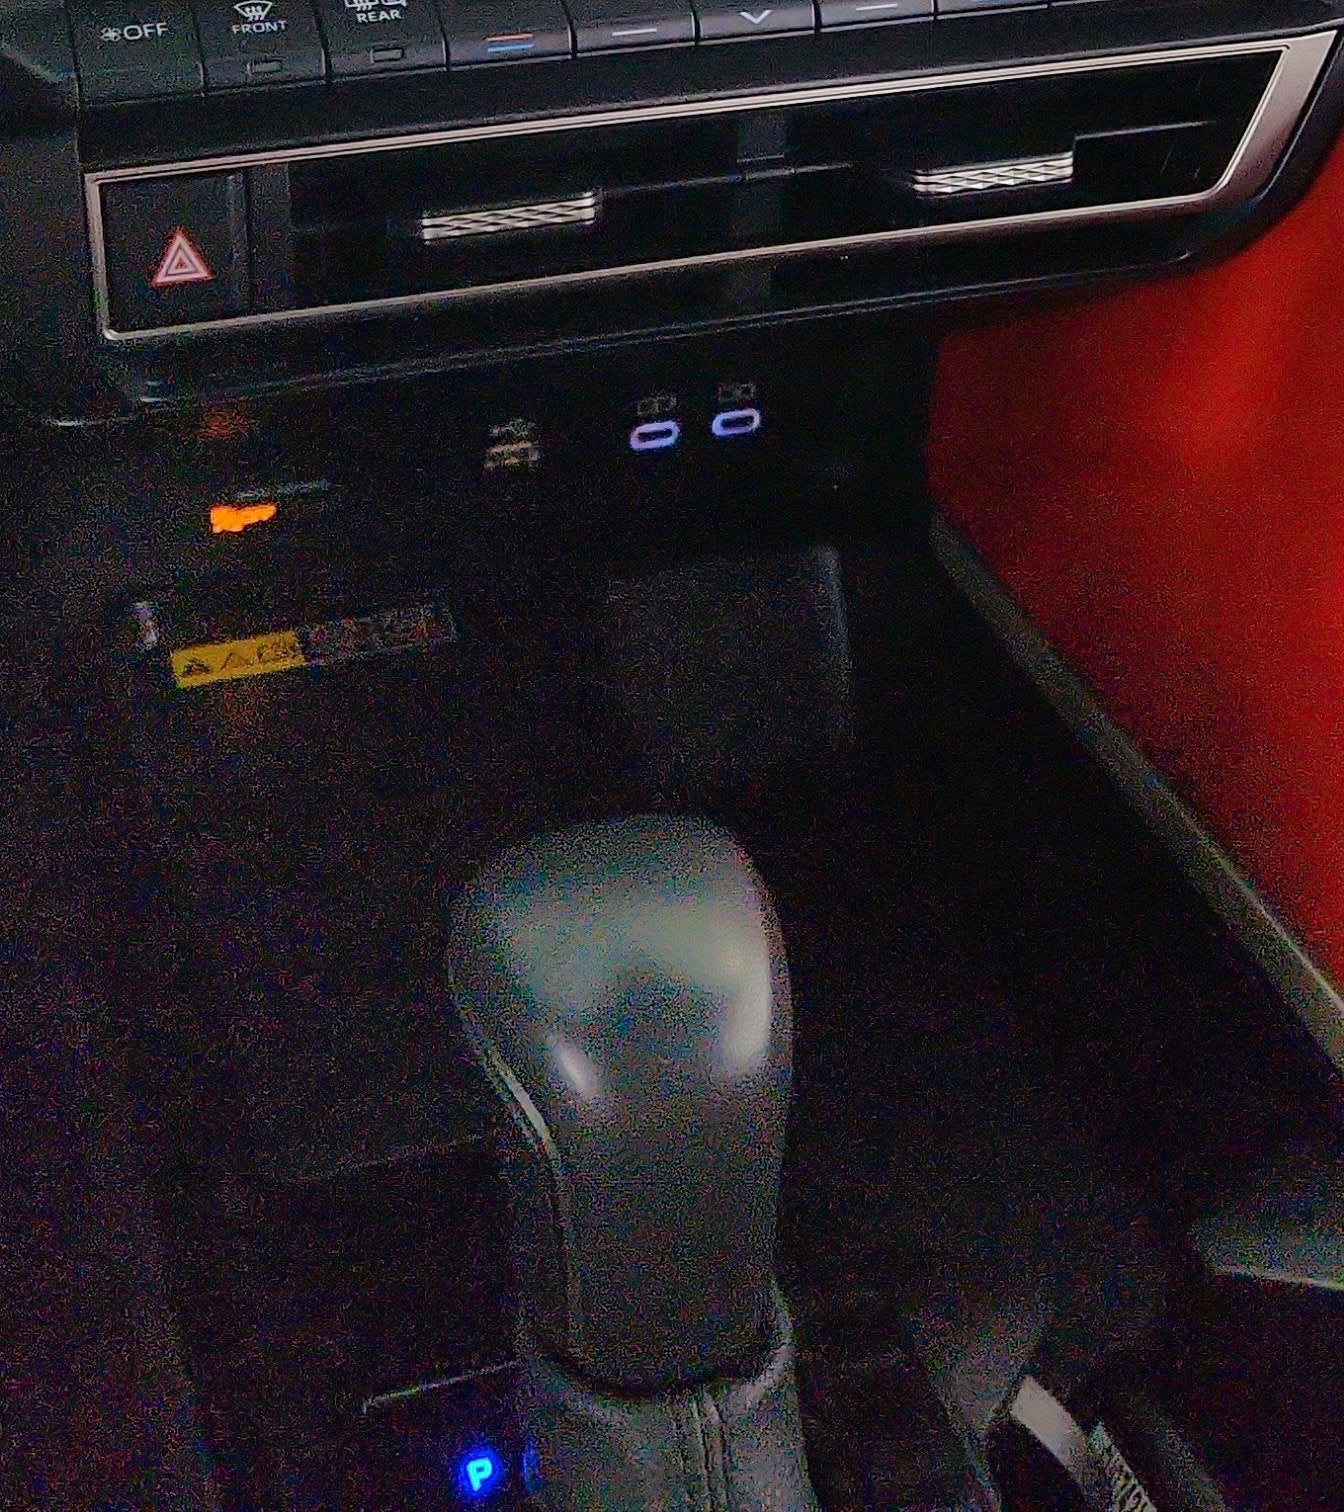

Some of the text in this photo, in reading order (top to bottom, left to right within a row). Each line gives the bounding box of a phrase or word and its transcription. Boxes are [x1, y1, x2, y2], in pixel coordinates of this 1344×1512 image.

[356, 8, 402, 24] REAR
[123, 20, 171, 43] OFF
[230, 18, 287, 36] FRONT
[467, 1457, 493, 1492] P
